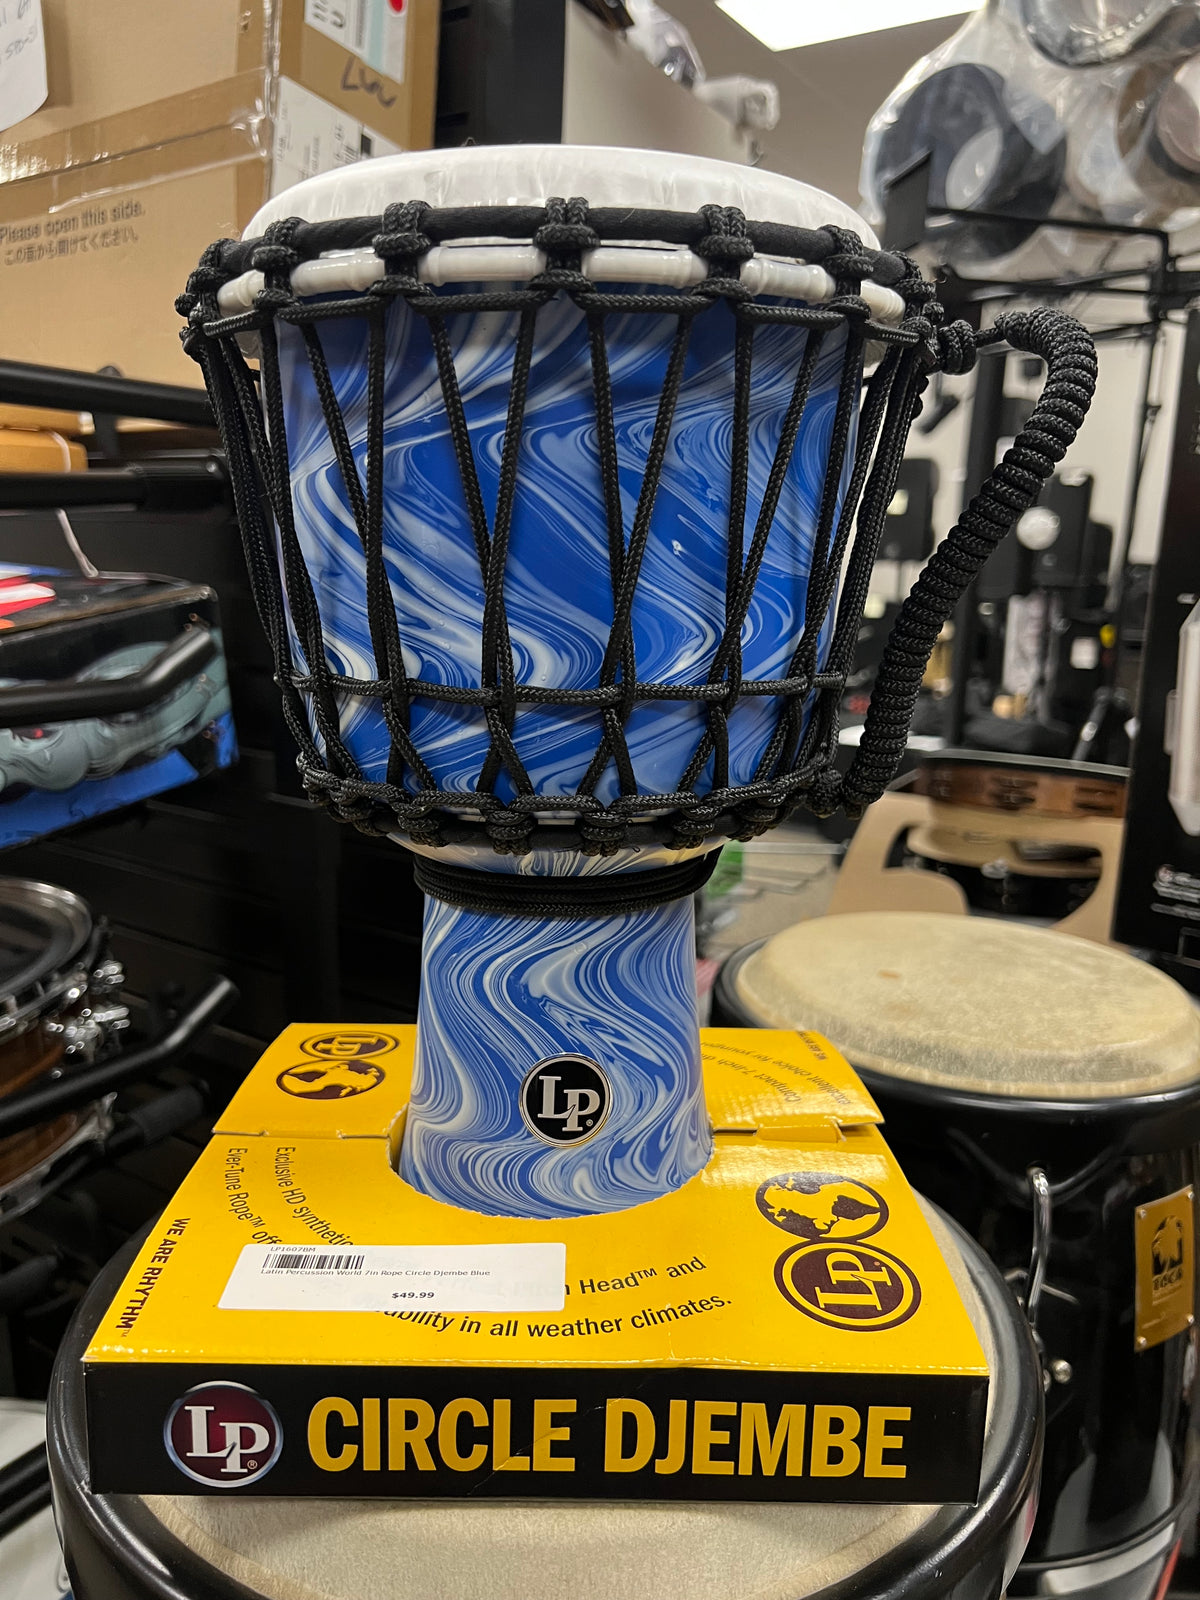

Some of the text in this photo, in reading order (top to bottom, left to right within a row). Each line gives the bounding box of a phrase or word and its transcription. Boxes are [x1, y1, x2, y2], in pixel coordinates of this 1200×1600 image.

[45, 216, 80, 236] open
[81, 206, 108, 229] this
[275, 1146, 296, 1188] Exclusive
[281, 1188, 306, 1205] HD
[166, 1217, 191, 1236] WE
[252, 1231, 283, 1245] off
[150, 1238, 178, 1264] ARE
[433, 1269, 469, 1277] Djembe
[666, 1256, 707, 1279] and
[391, 1291, 435, 1299] $49.99
[459, 1315, 481, 1334] in
[490, 1320, 519, 1337] all
[527, 1316, 624, 1337] weather
[630, 1294, 732, 1329] climates.
[307, 1397, 578, 1472] CIRCLE
[604, 1398, 911, 1478] DJEMBE
